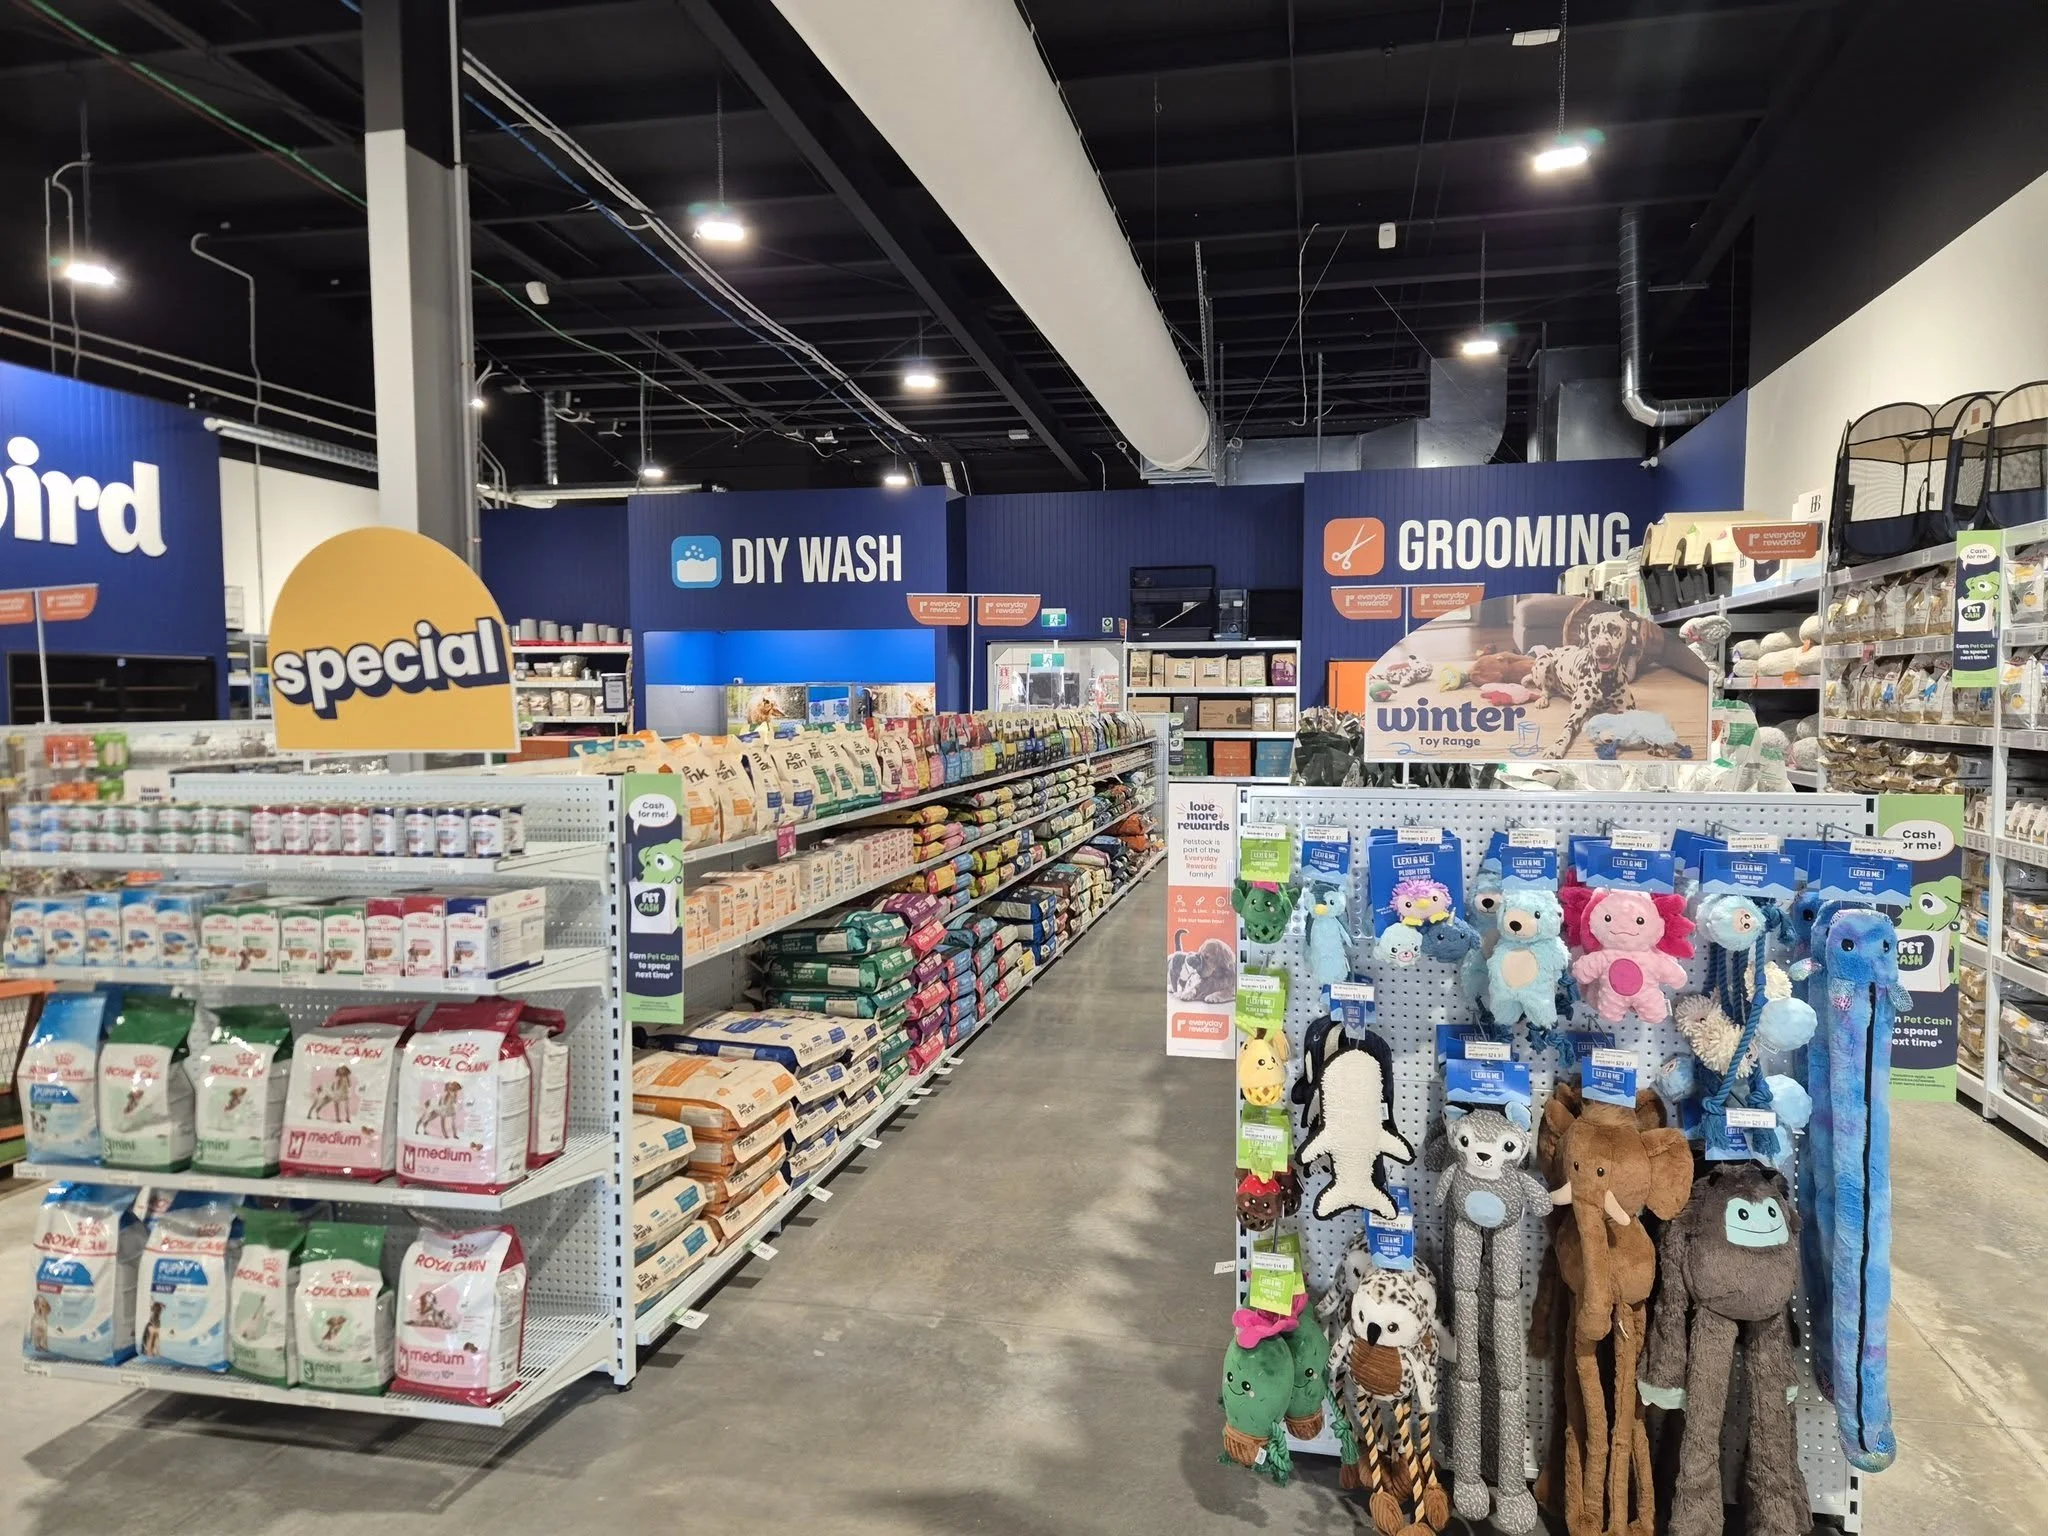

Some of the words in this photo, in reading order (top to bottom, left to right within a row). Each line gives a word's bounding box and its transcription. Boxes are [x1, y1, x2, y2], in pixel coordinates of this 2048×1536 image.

[0, 437, 167, 557] ird
[1398, 512, 1630, 571] GROOMING
[1763, 531, 1807, 541] everyday
[1763, 538, 1801, 546] rewards
[732, 537, 789, 583] DIY
[799, 535, 901, 583] WASH
[272, 616, 509, 719] special
[1377, 697, 1526, 732] winter
[1419, 736, 1440, 749] Toy
[1443, 736, 1481, 749] Range
[642, 801, 664, 810] Cash
[1189, 801, 1215, 811] love
[638, 810, 650, 818] for
[651, 810, 669, 818] me!
[1186, 811, 1218, 821] more
[1177, 820, 1230, 831] rewards
[1902, 828, 1936, 840] Cash
[1183, 838, 1213, 846] Petstock
[1916, 841, 1941, 850] me!
[1183, 846, 1198, 854] part
[1397, 857, 1412, 865] LEXI
[1419, 855, 1430, 863] ME
[1754, 864, 1763, 872] ME
[1189, 871, 1213, 879] family!
[641, 892, 659, 904] PET
[638, 903, 659, 912] CASH
[1898, 941, 1924, 954] PET
[629, 952, 646, 960] Earn
[647, 952, 659, 961] Pet
[660, 952, 680, 961] Cash
[1897, 954, 1923, 966] ASH
[647, 962, 670, 971] spend
[1903, 1015, 1921, 1024] Pet
[1924, 1016, 1952, 1026] Cash
[1903, 1027, 1938, 1037] spend
[1892, 1038, 1909, 1046] ext
[305, 1042, 340, 1055] ROYAL
[344, 1046, 383, 1059] CANIN
[413, 1054, 450, 1069] ROYAL
[456, 1060, 490, 1073] CANIN
[308, 1131, 362, 1146] medium
[417, 1146, 472, 1162] medium
[416, 1254, 451, 1272] ROYAL
[410, 1350, 464, 1365] medium
